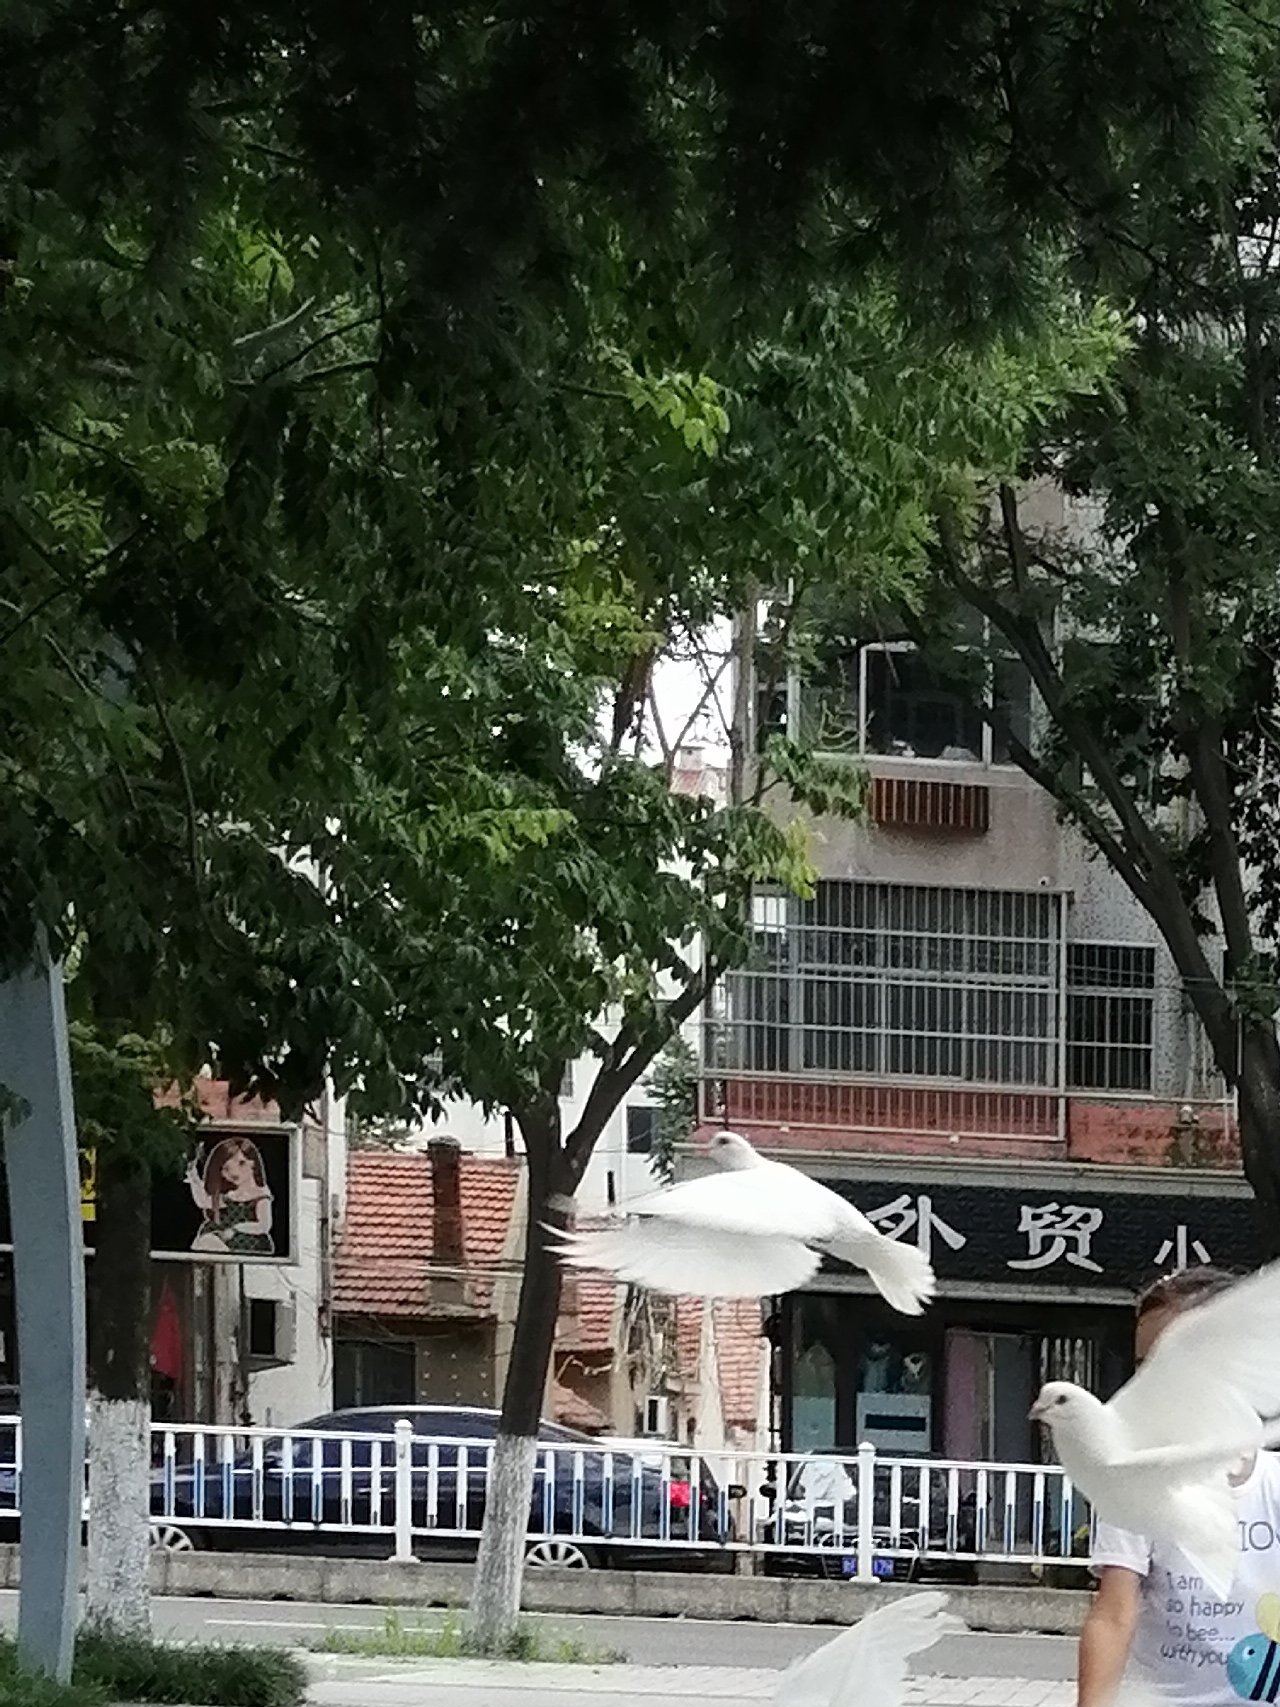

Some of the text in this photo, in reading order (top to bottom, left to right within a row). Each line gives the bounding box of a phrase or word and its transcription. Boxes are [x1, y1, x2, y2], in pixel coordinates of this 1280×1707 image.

[1190, 1596, 1245, 1617] happy
[1161, 1644, 1230, 1668] with you
